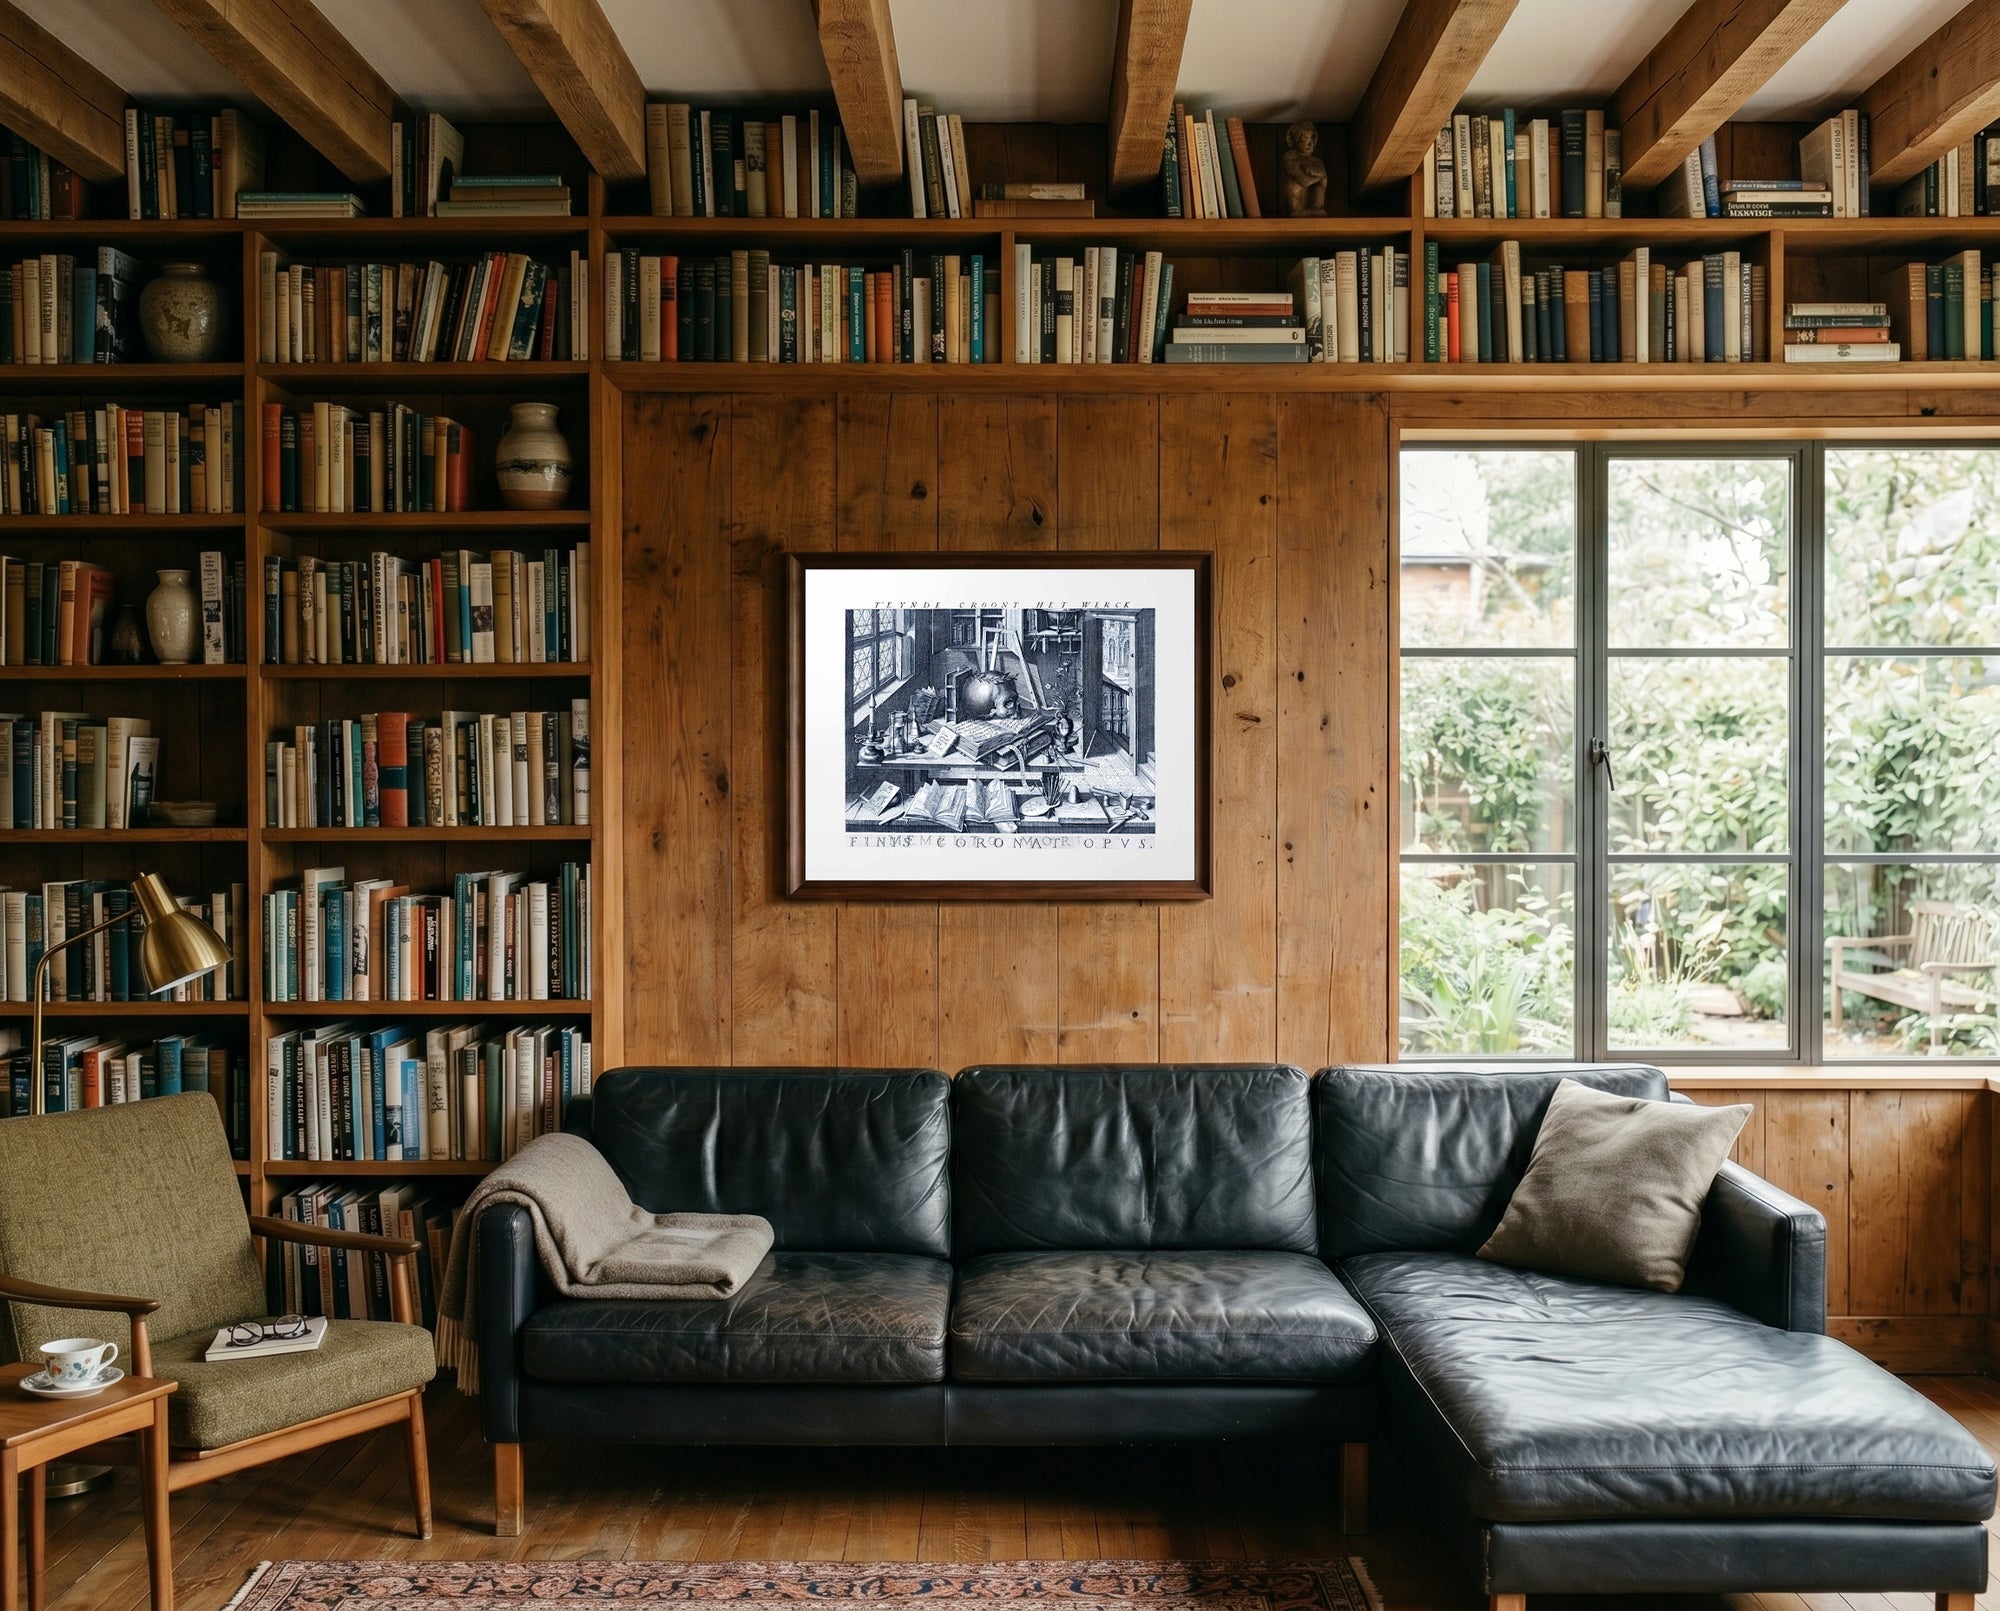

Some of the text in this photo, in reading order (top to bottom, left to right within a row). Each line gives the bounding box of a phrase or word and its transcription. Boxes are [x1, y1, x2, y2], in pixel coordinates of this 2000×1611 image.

[1036, 601, 1068, 609] HET
[1082, 601, 1131, 609] WERCK
[1083, 837, 1153, 849] OPVS.
